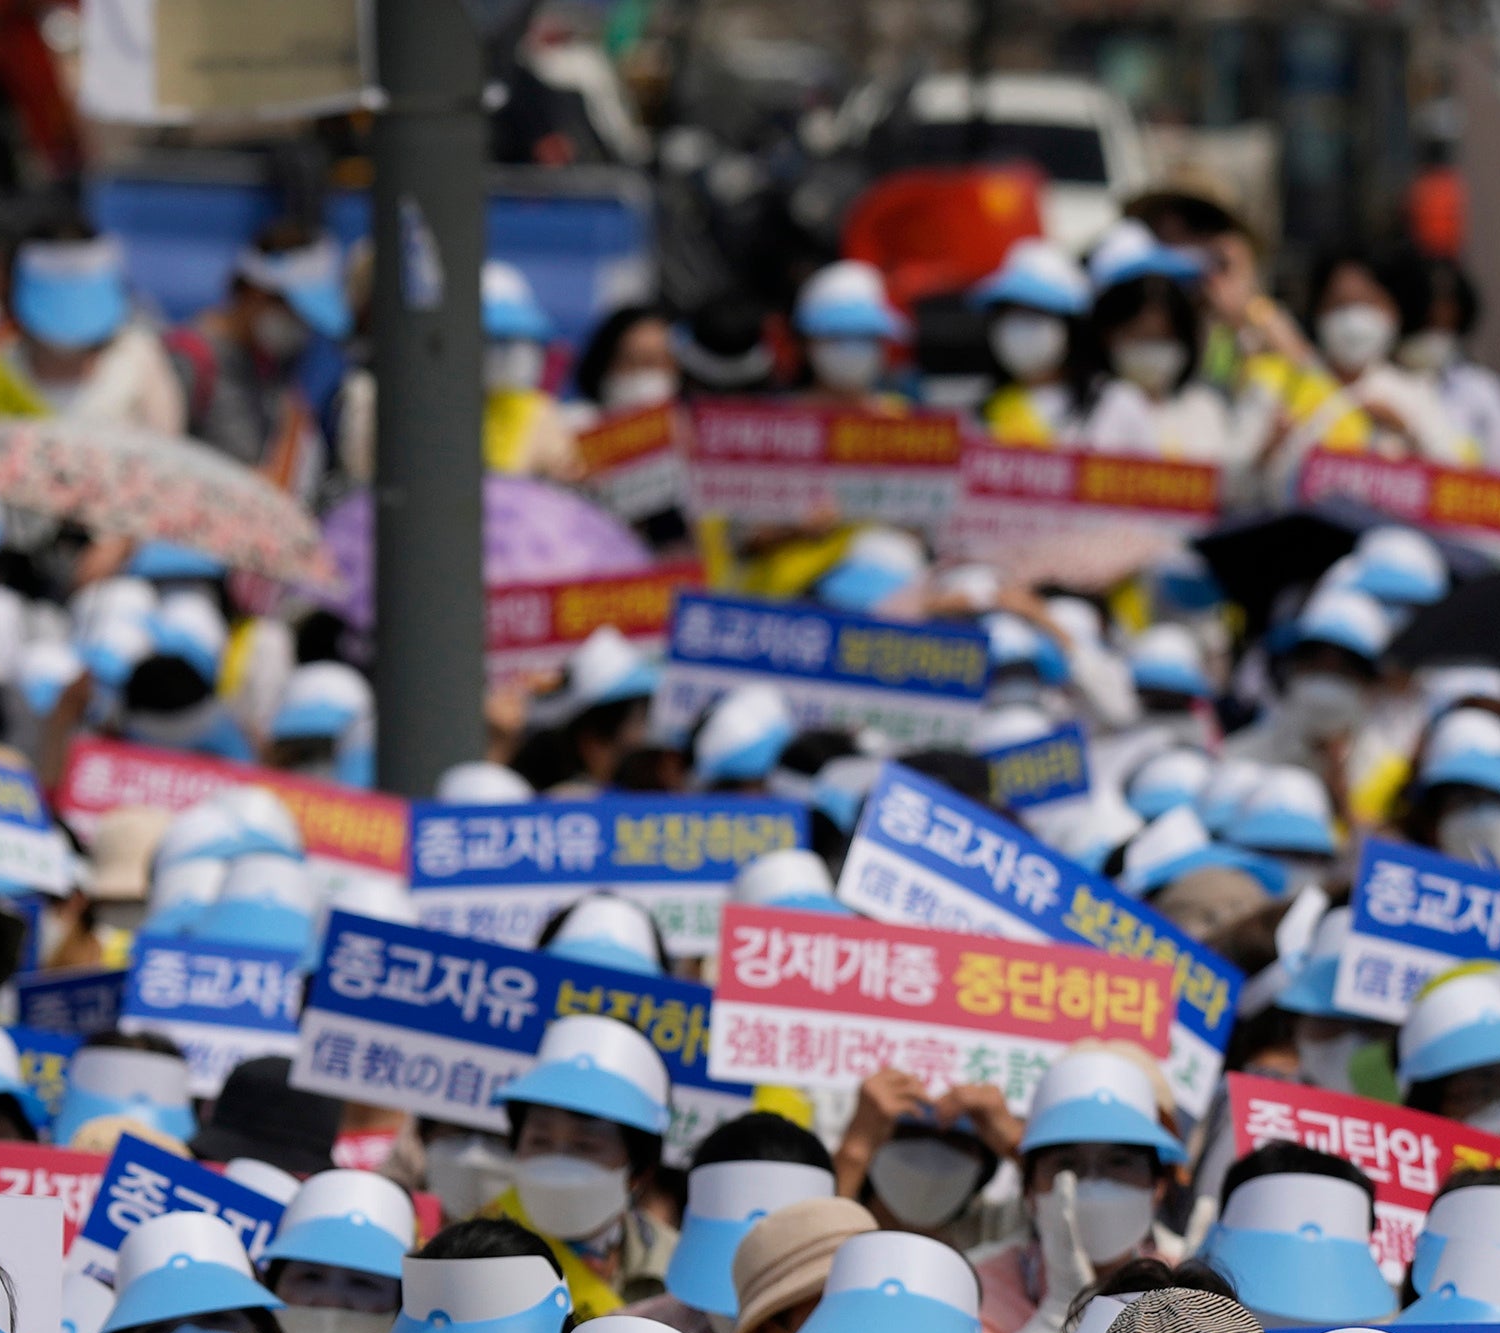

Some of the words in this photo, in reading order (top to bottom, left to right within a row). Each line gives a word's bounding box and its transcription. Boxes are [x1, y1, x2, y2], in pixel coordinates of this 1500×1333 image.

[416, 813, 604, 878] 종교자유
[612, 810, 798, 872] 보장하라
[876, 783, 1064, 916] 종교자유
[328, 930, 540, 1033] 종교자유
[731, 924, 941, 1008] 강제개종
[953, 950, 1165, 1041] 중단하라
